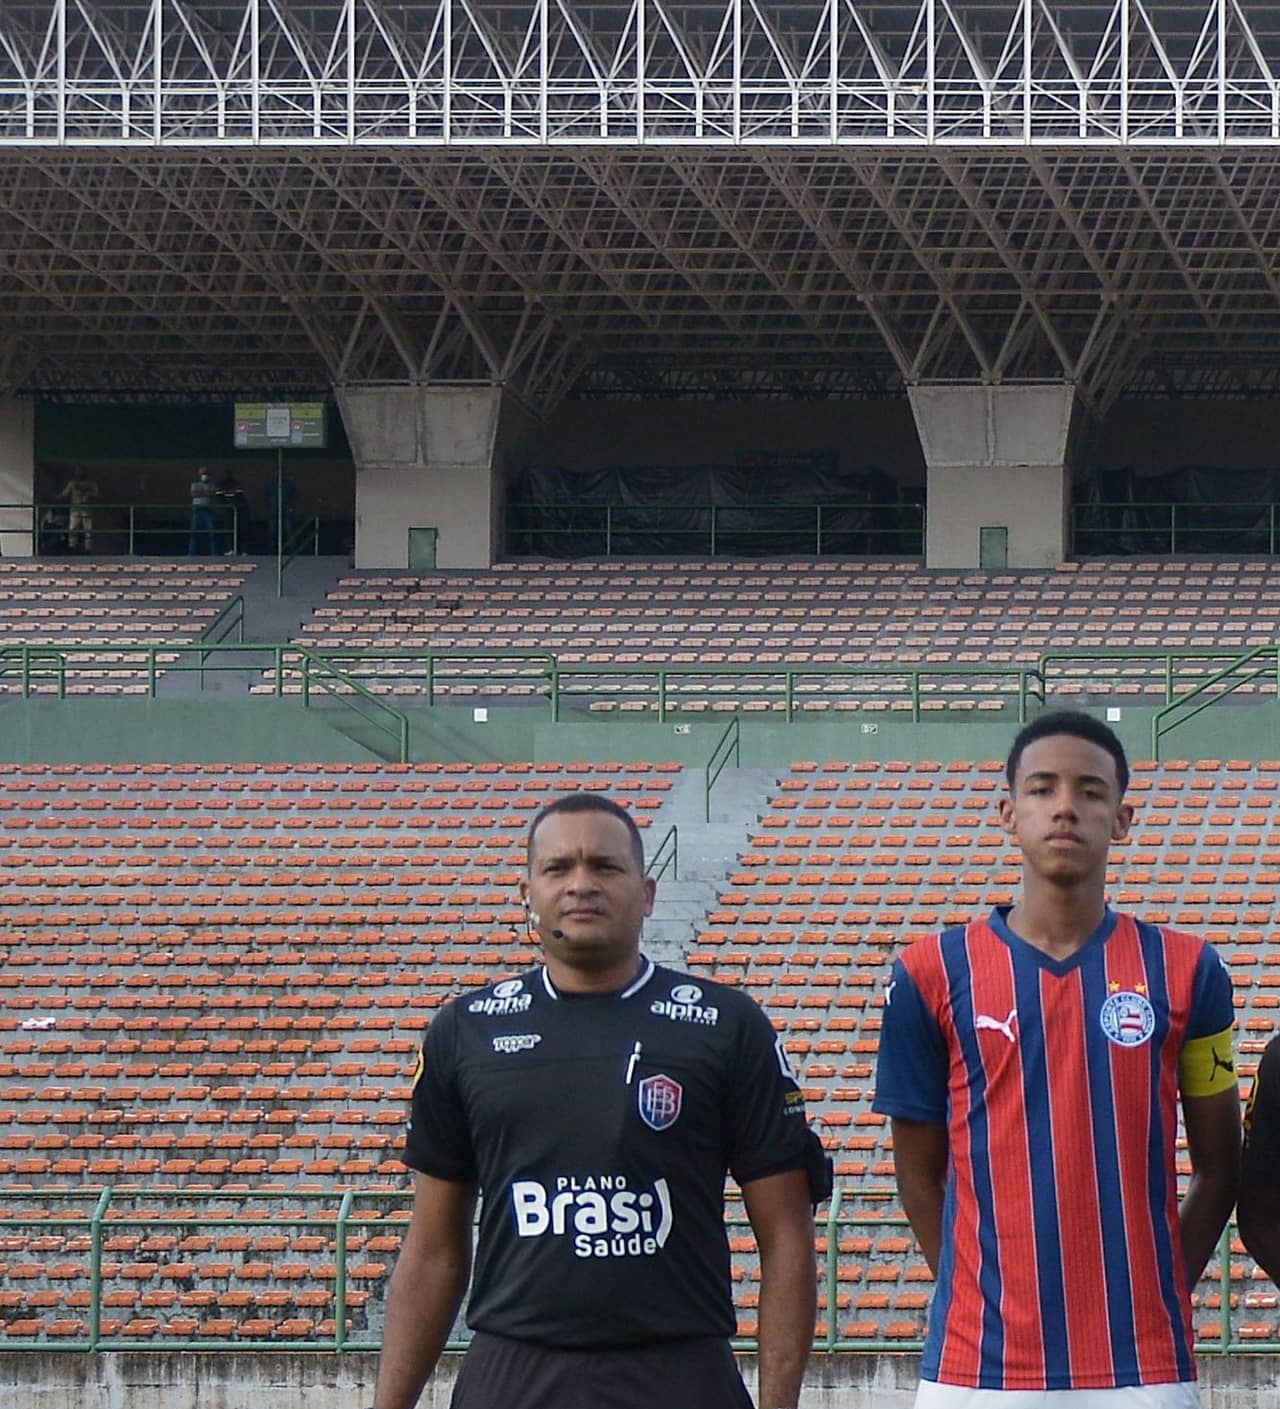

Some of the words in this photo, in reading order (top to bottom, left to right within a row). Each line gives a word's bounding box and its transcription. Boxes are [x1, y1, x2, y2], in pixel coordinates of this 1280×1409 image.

[650, 999, 718, 1020] alpha
[557, 1176, 627, 1191] PLANO
[575, 1233, 657, 1257] Saúde
